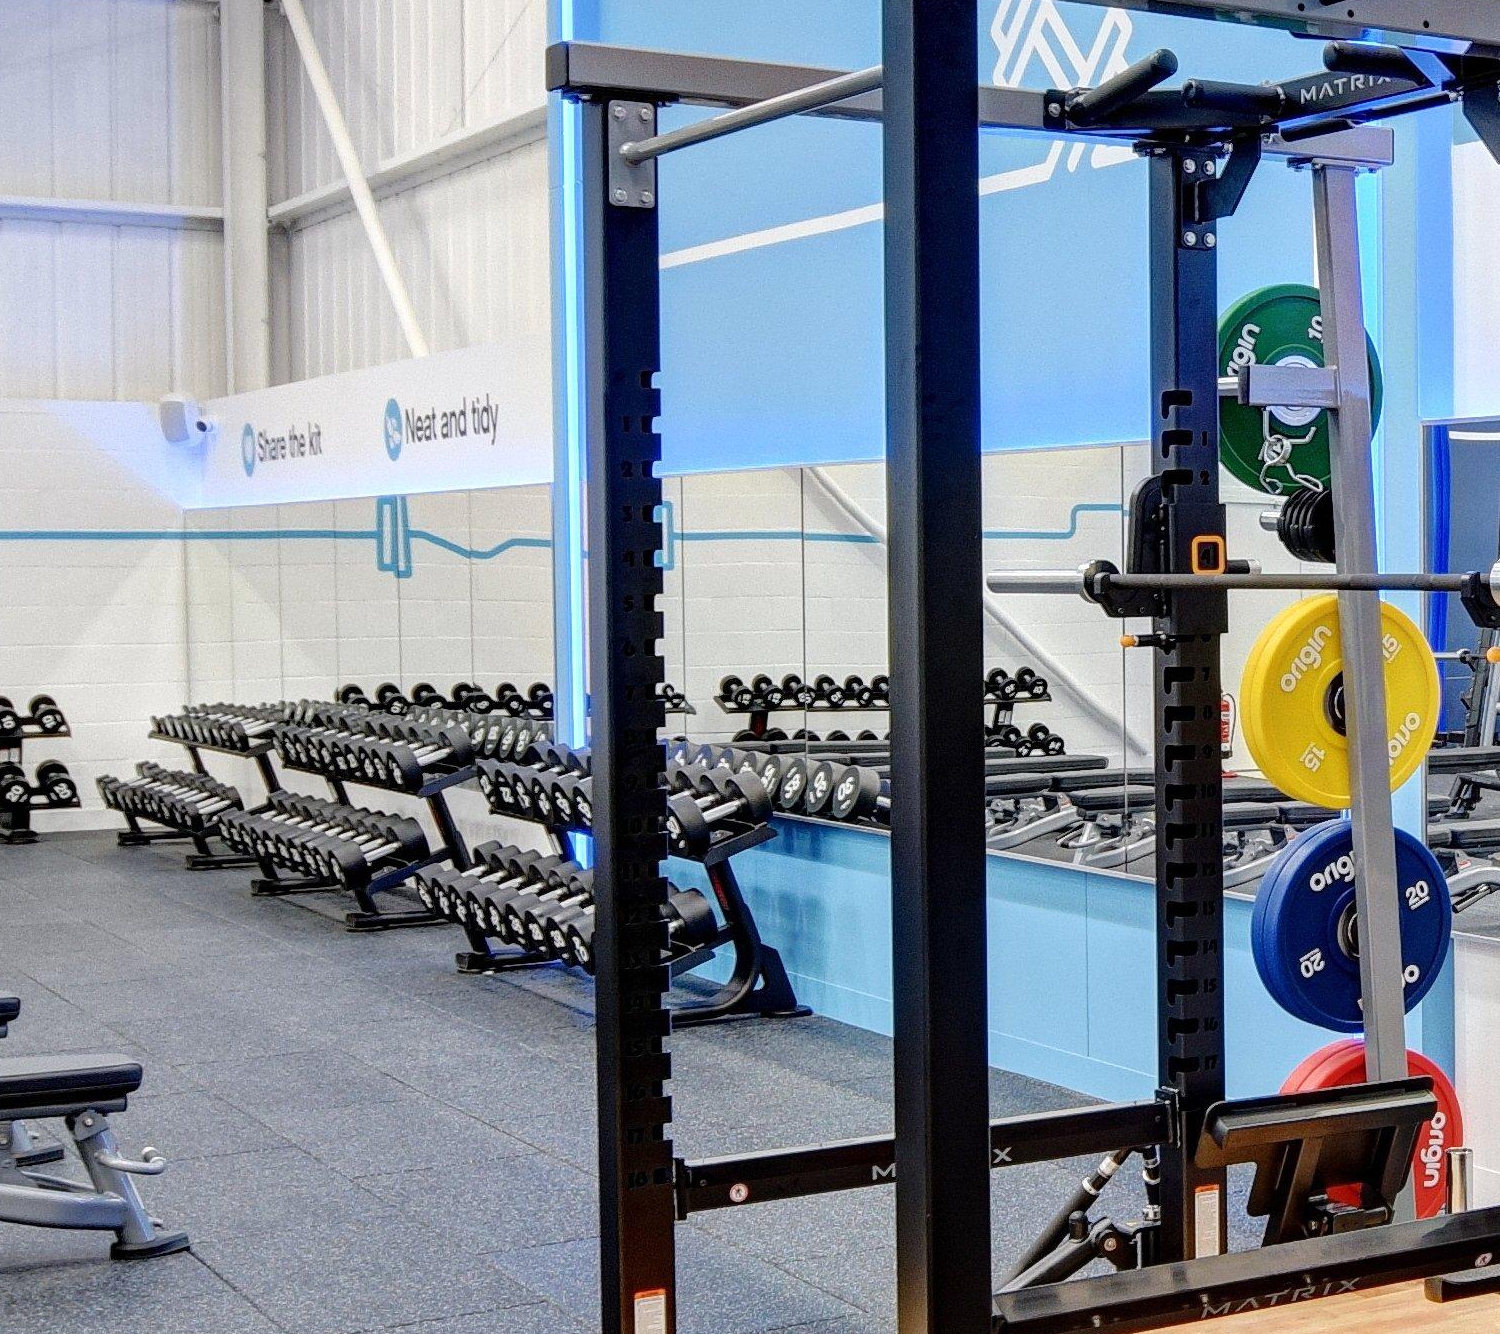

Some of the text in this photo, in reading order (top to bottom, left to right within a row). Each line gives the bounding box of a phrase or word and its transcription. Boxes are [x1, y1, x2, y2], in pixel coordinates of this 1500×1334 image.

[404, 393, 499, 446] Neat and tidy
[257, 422, 323, 463] Share the kit
[1281, 625, 1332, 692] origin
[1300, 741, 1326, 773] 15
[1309, 850, 1356, 892] orig
[1405, 880, 1430, 910] 20
[1299, 948, 1325, 978] 20
[1420, 1111, 1446, 1188] origin
[1201, 1277, 1362, 1319] MATRIX
